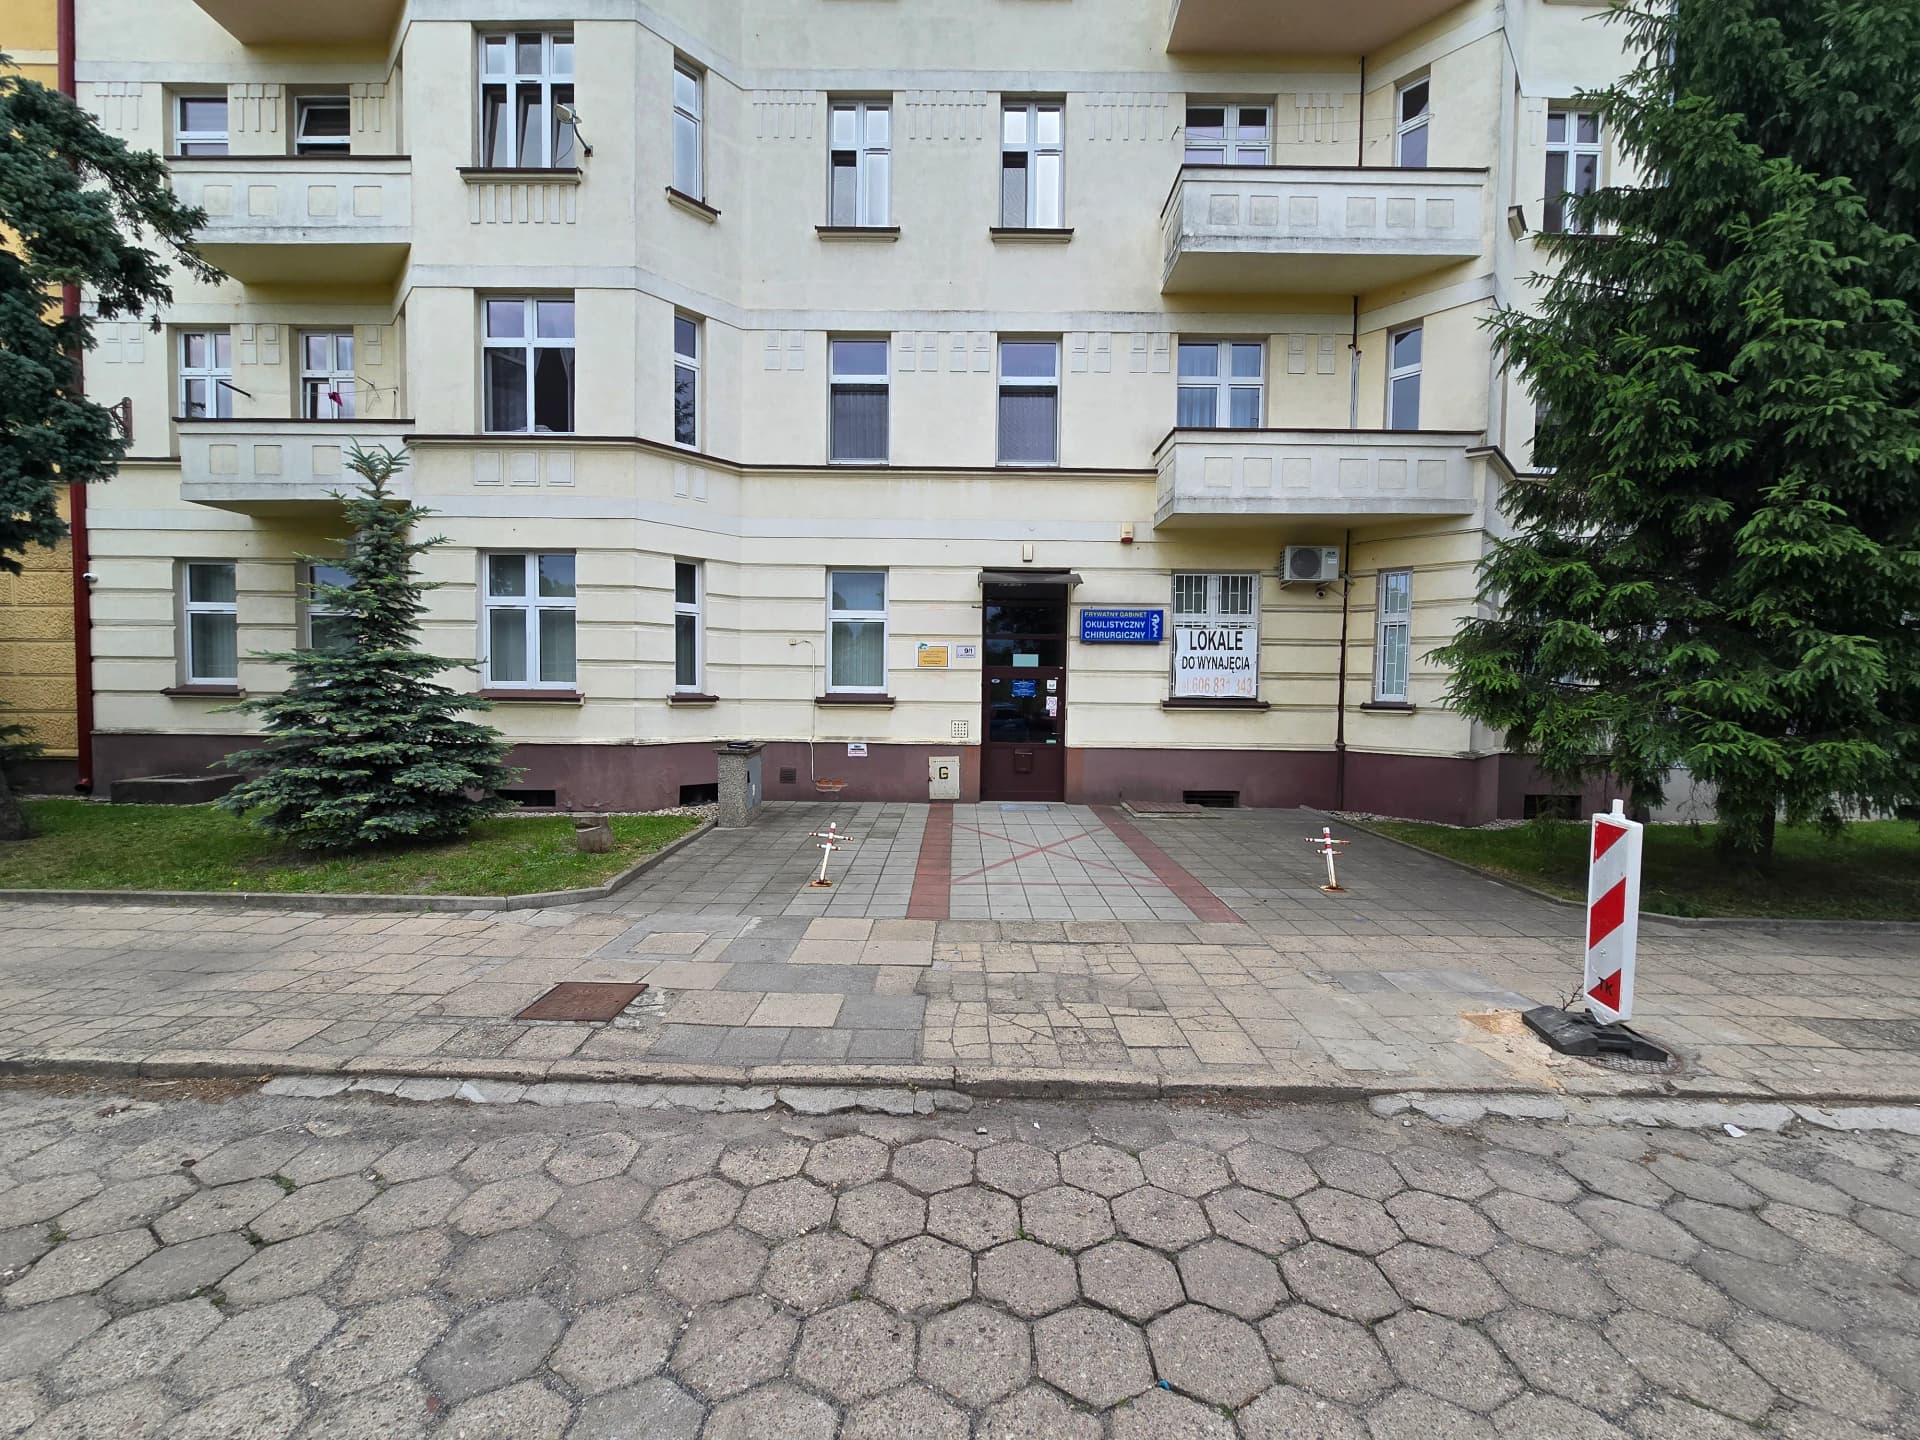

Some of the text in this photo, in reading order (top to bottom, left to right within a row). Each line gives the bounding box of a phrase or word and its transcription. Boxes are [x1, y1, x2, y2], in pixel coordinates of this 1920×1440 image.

[1085, 620, 1146, 629] OKULISTYCZNY
[1084, 631, 1146, 639] CHIRURGICZNY
[1189, 630, 1244, 651] LOKALE
[1181, 655, 1250, 674] DO WYNAJĘCIA
[939, 766, 949, 779] G
[1598, 976, 1613, 997] TK
